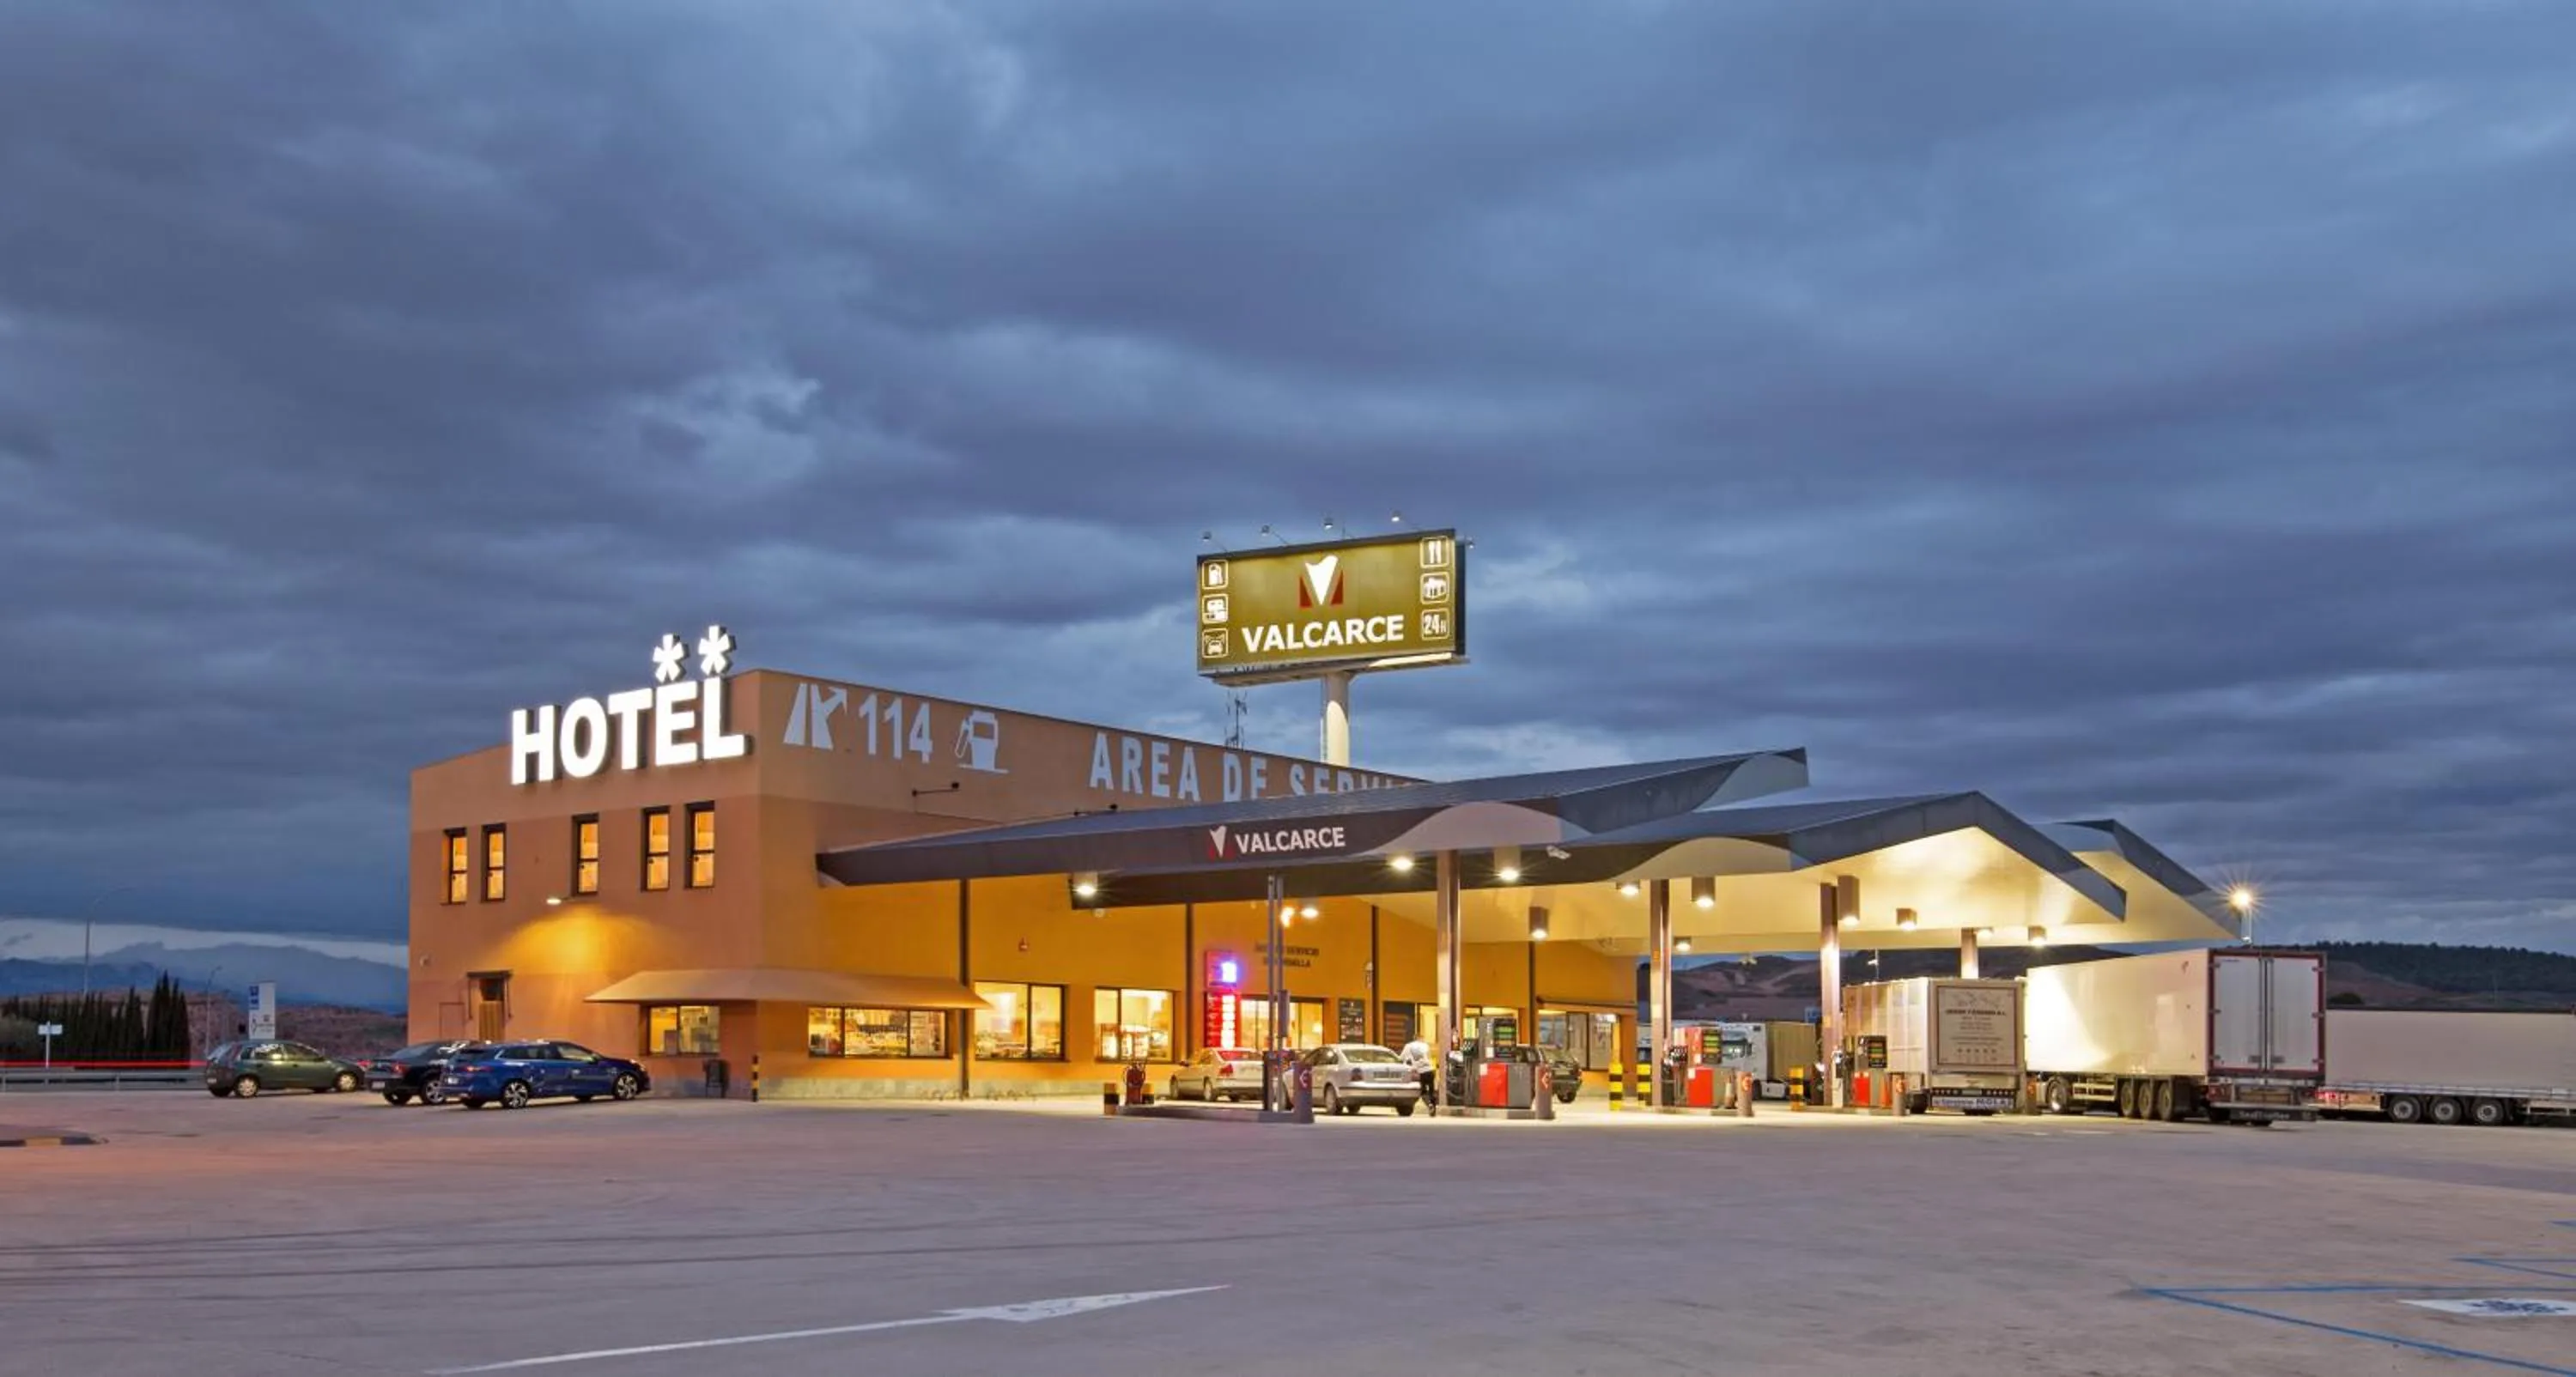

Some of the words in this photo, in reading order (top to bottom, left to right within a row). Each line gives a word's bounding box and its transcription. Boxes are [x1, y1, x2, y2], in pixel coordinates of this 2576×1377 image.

[1241, 614, 1405, 653] VALCARCE
[511, 676, 747, 785] HOTEL
[859, 692, 933, 763] 114
[1090, 731, 1201, 803] AREA
[1223, 751, 1267, 802] DE
[1235, 827, 1345, 855] VALCARCE
